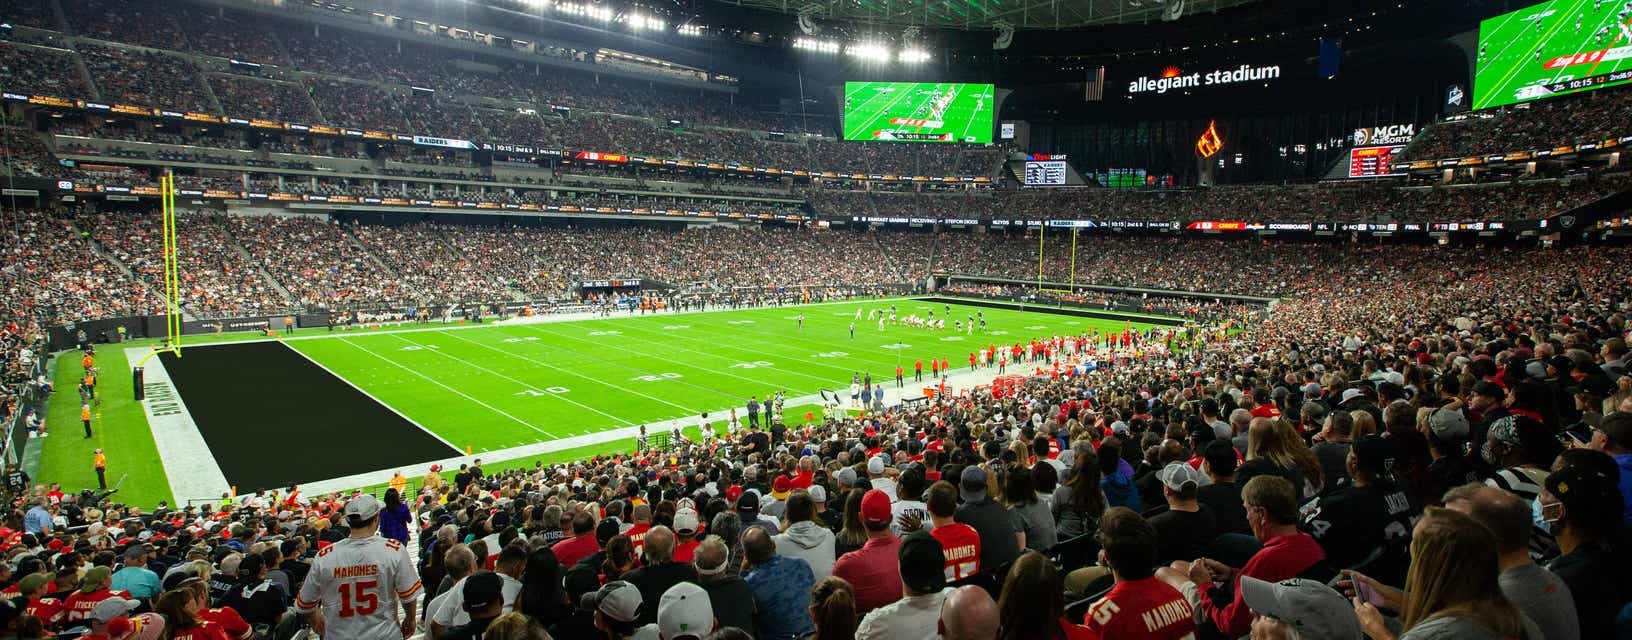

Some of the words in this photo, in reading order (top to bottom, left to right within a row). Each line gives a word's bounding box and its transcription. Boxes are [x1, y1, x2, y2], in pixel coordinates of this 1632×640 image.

[1129, 71, 1200, 93] allegiant
[1205, 64, 1280, 85] stadium
[1570, 79, 1592, 89] 10:15
[1374, 124, 1413, 137] MGM
[418, 137, 448, 145] RAIDERS
[1373, 136, 1412, 144] RESORTS
[9, 476, 23, 486] 24
[903, 508, 931, 521] BROWN
[942, 544, 976, 560] MAHOMES
[333, 564, 379, 579] MAHOMES
[337, 579, 379, 618] 15
[1093, 599, 1121, 626] 5
[1141, 598, 1192, 633] MAHOME
